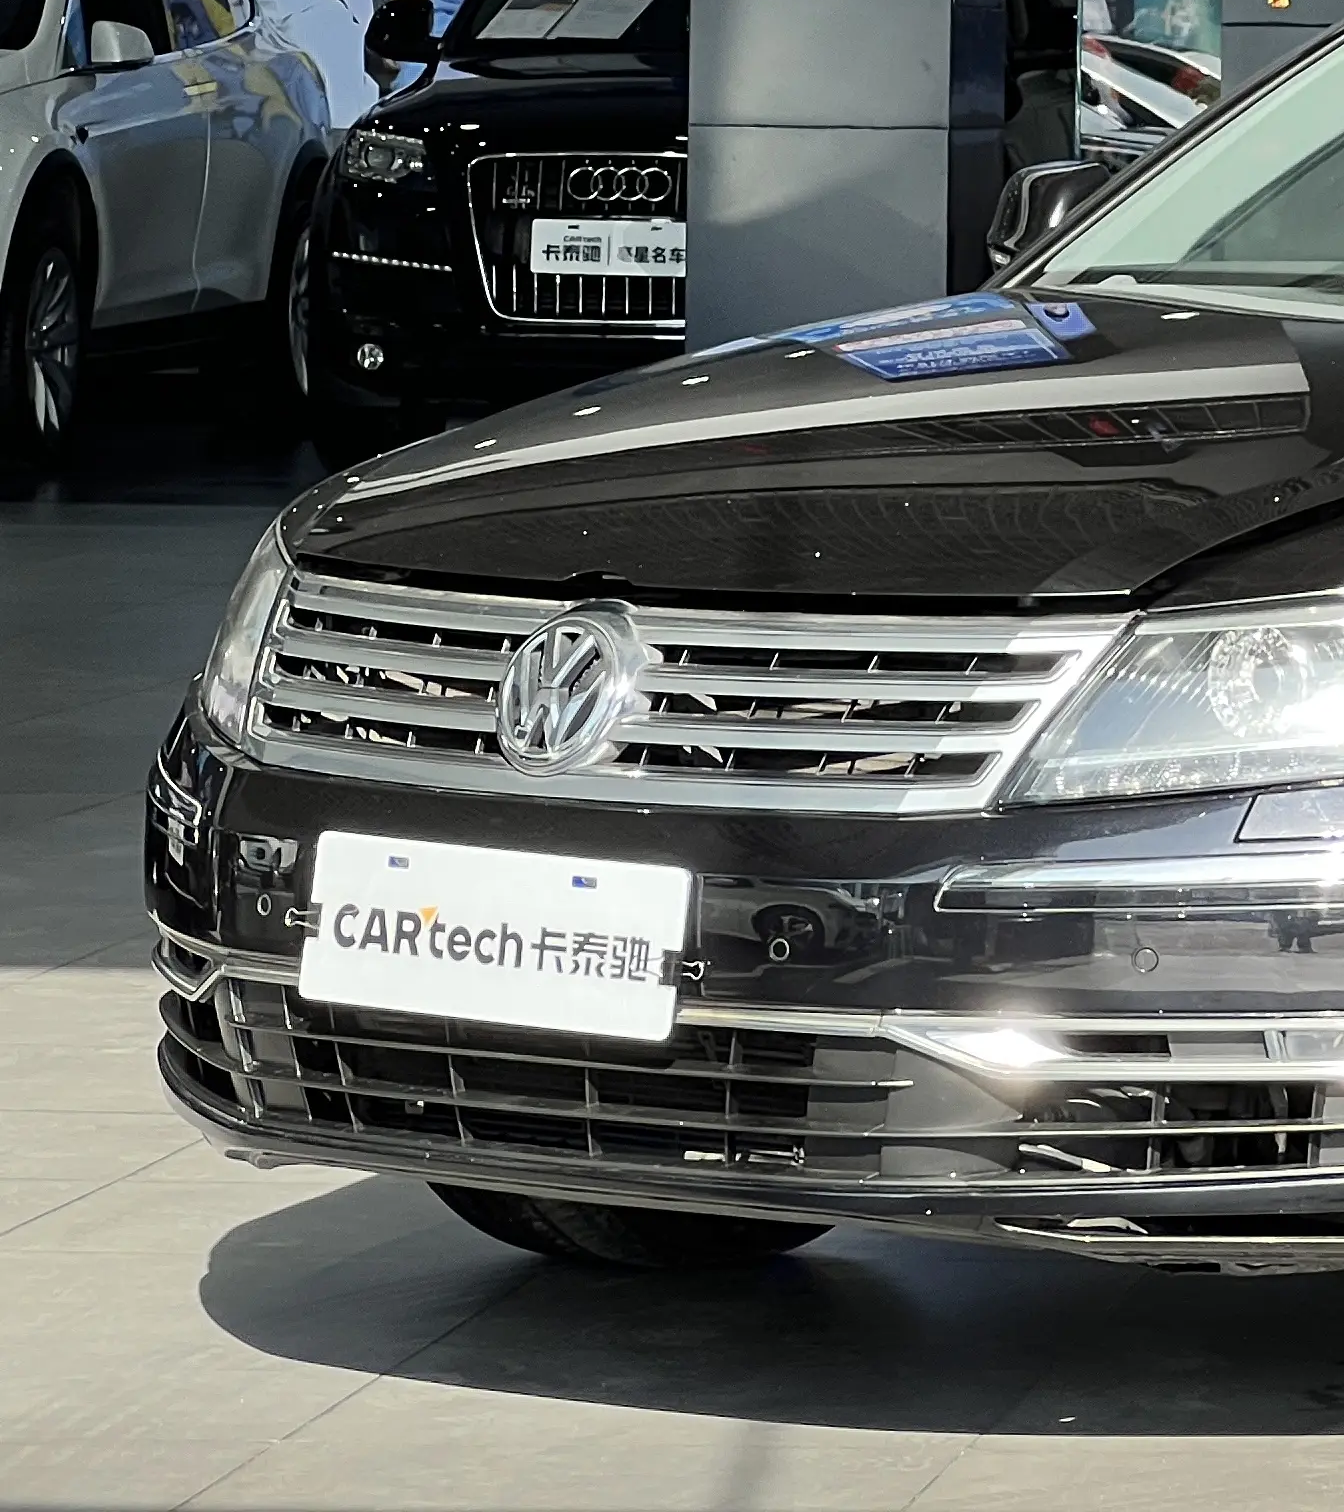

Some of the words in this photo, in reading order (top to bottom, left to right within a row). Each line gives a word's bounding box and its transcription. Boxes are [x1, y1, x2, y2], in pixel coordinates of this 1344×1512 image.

[333, 902, 523, 969] CARtech
[531, 926, 651, 983] 卡泰驰
